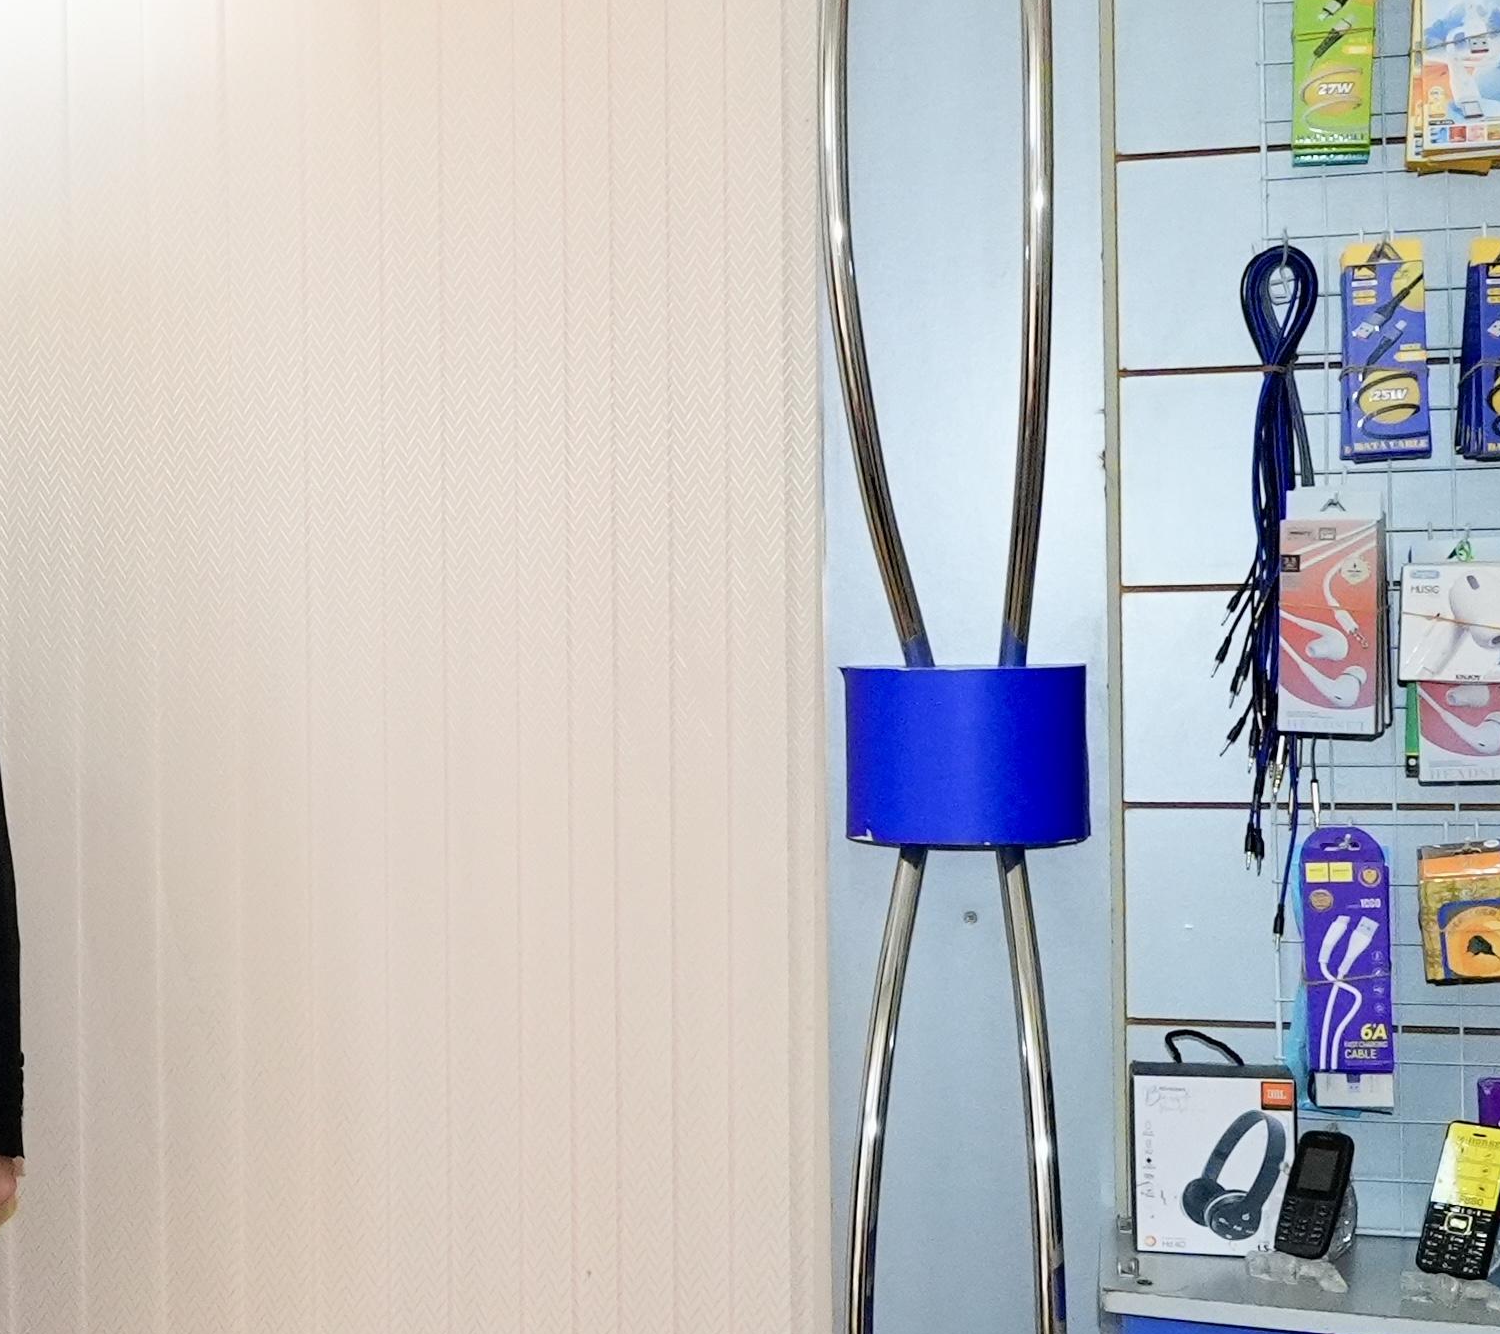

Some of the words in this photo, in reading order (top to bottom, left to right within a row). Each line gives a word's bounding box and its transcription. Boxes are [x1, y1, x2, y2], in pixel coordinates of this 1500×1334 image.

[1318, 81, 1353, 96] 27W
[1371, 388, 1408, 401] 25W
[1353, 441, 1390, 453] DATA
[1391, 439, 1429, 450] CABLE
[1410, 584, 1440, 595] MUSIC
[1344, 1048, 1378, 1060] CABLE
